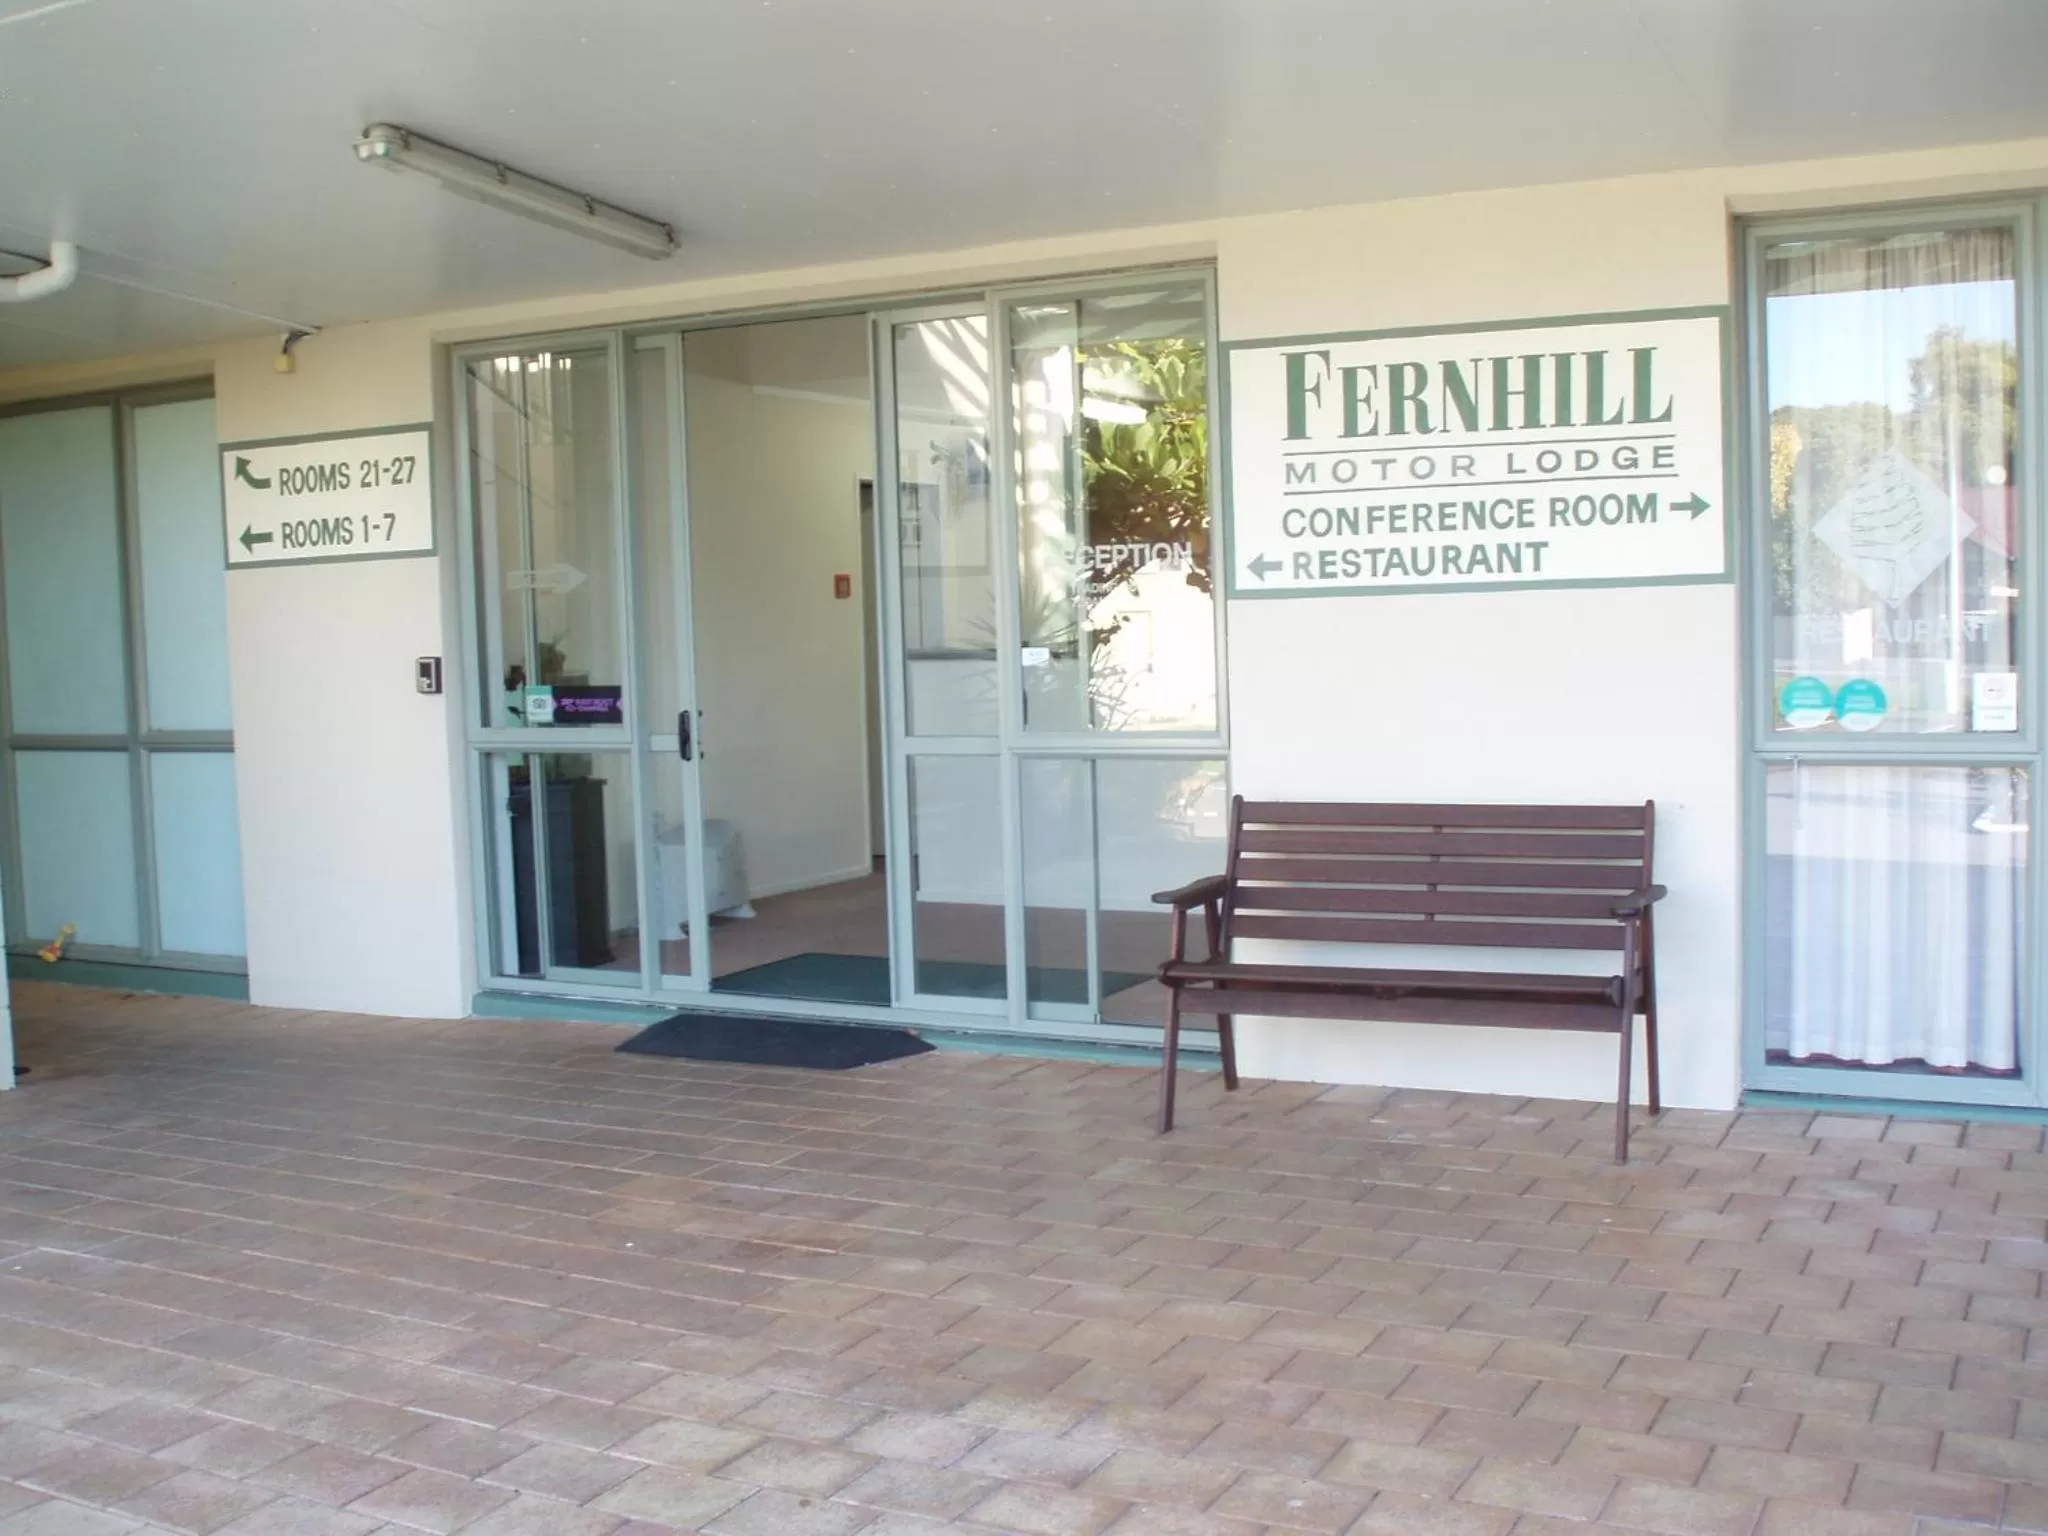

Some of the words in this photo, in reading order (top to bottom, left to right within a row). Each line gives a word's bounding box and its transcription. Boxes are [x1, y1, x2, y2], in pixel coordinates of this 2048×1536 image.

[1281, 347, 1674, 440] FERNHILL
[279, 462, 351, 496] ROOMS
[359, 456, 416, 489] 21-27
[1284, 454, 1477, 485] MOTOR
[1506, 445, 1676, 475] LODGE
[281, 517, 353, 549] ROOMS
[361, 512, 396, 543] 1-7
[1282, 499, 1535, 539] CONFERENCE
[1549, 492, 1658, 527] ROOM
[1292, 541, 1549, 580] RESTAURANT
